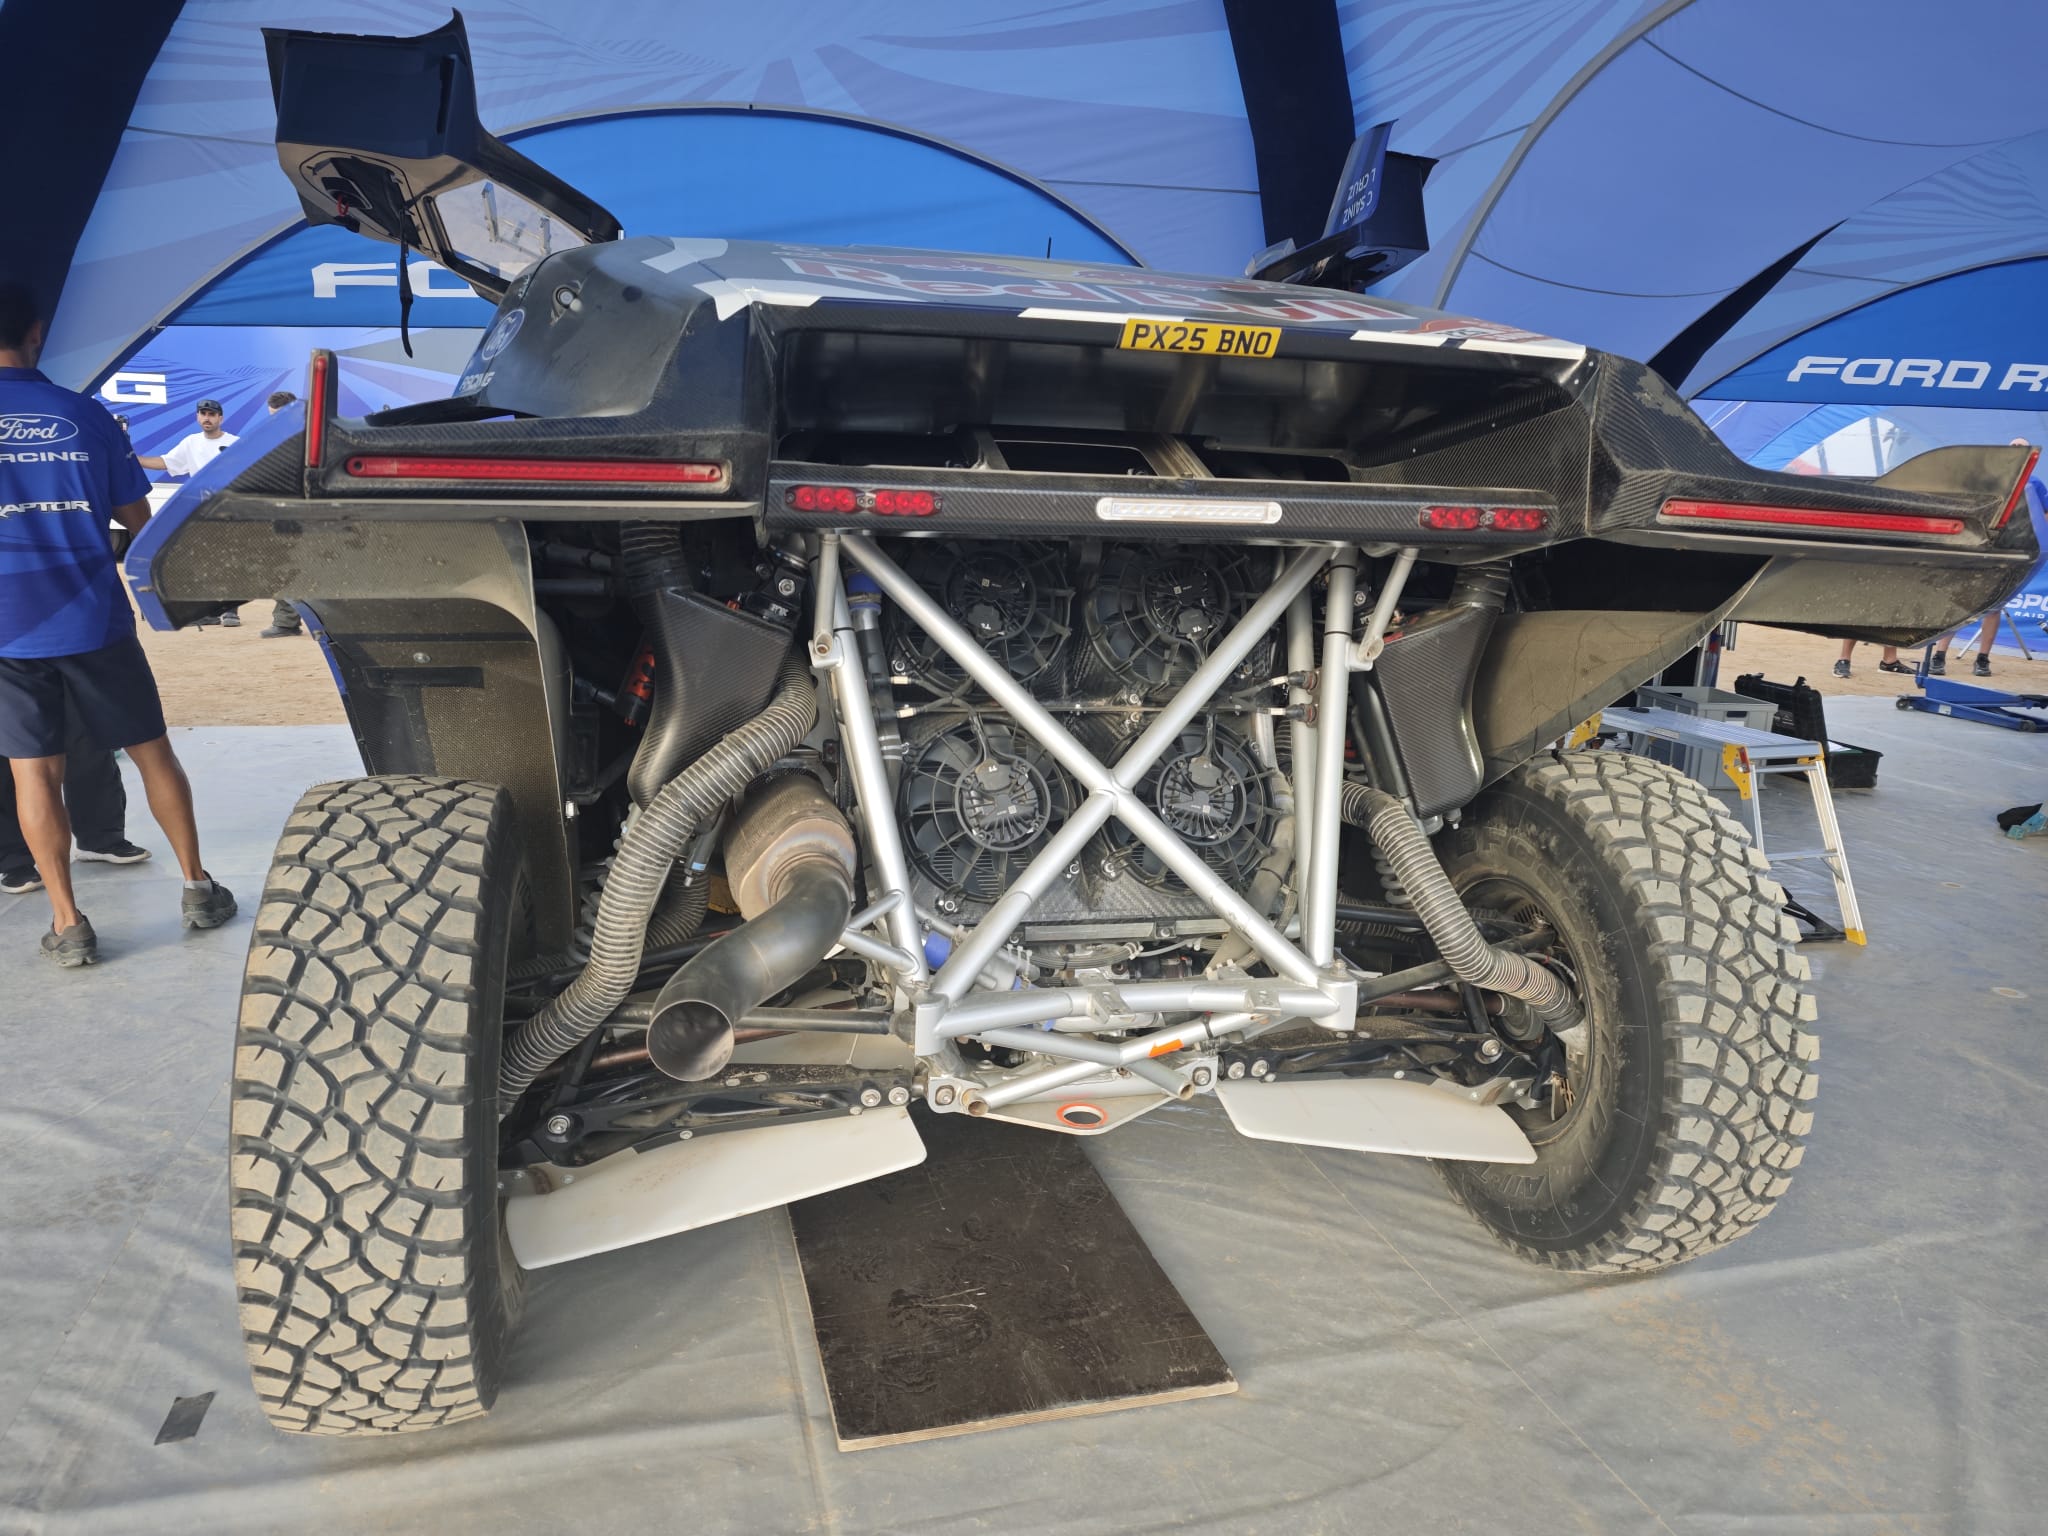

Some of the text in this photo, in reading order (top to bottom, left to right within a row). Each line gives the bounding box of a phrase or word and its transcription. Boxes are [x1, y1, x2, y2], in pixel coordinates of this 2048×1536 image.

[1347, 172, 1370, 201] CRUZ
[1342, 194, 1366, 225] SAINZ
[778, 258, 1419, 322] Red Bull
[1130, 323, 1273, 355] PX25 BNO
[1787, 355, 2048, 393] FORD R
[0, 417, 59, 440] Ford
[2014, 611, 2046, 619] RAID
